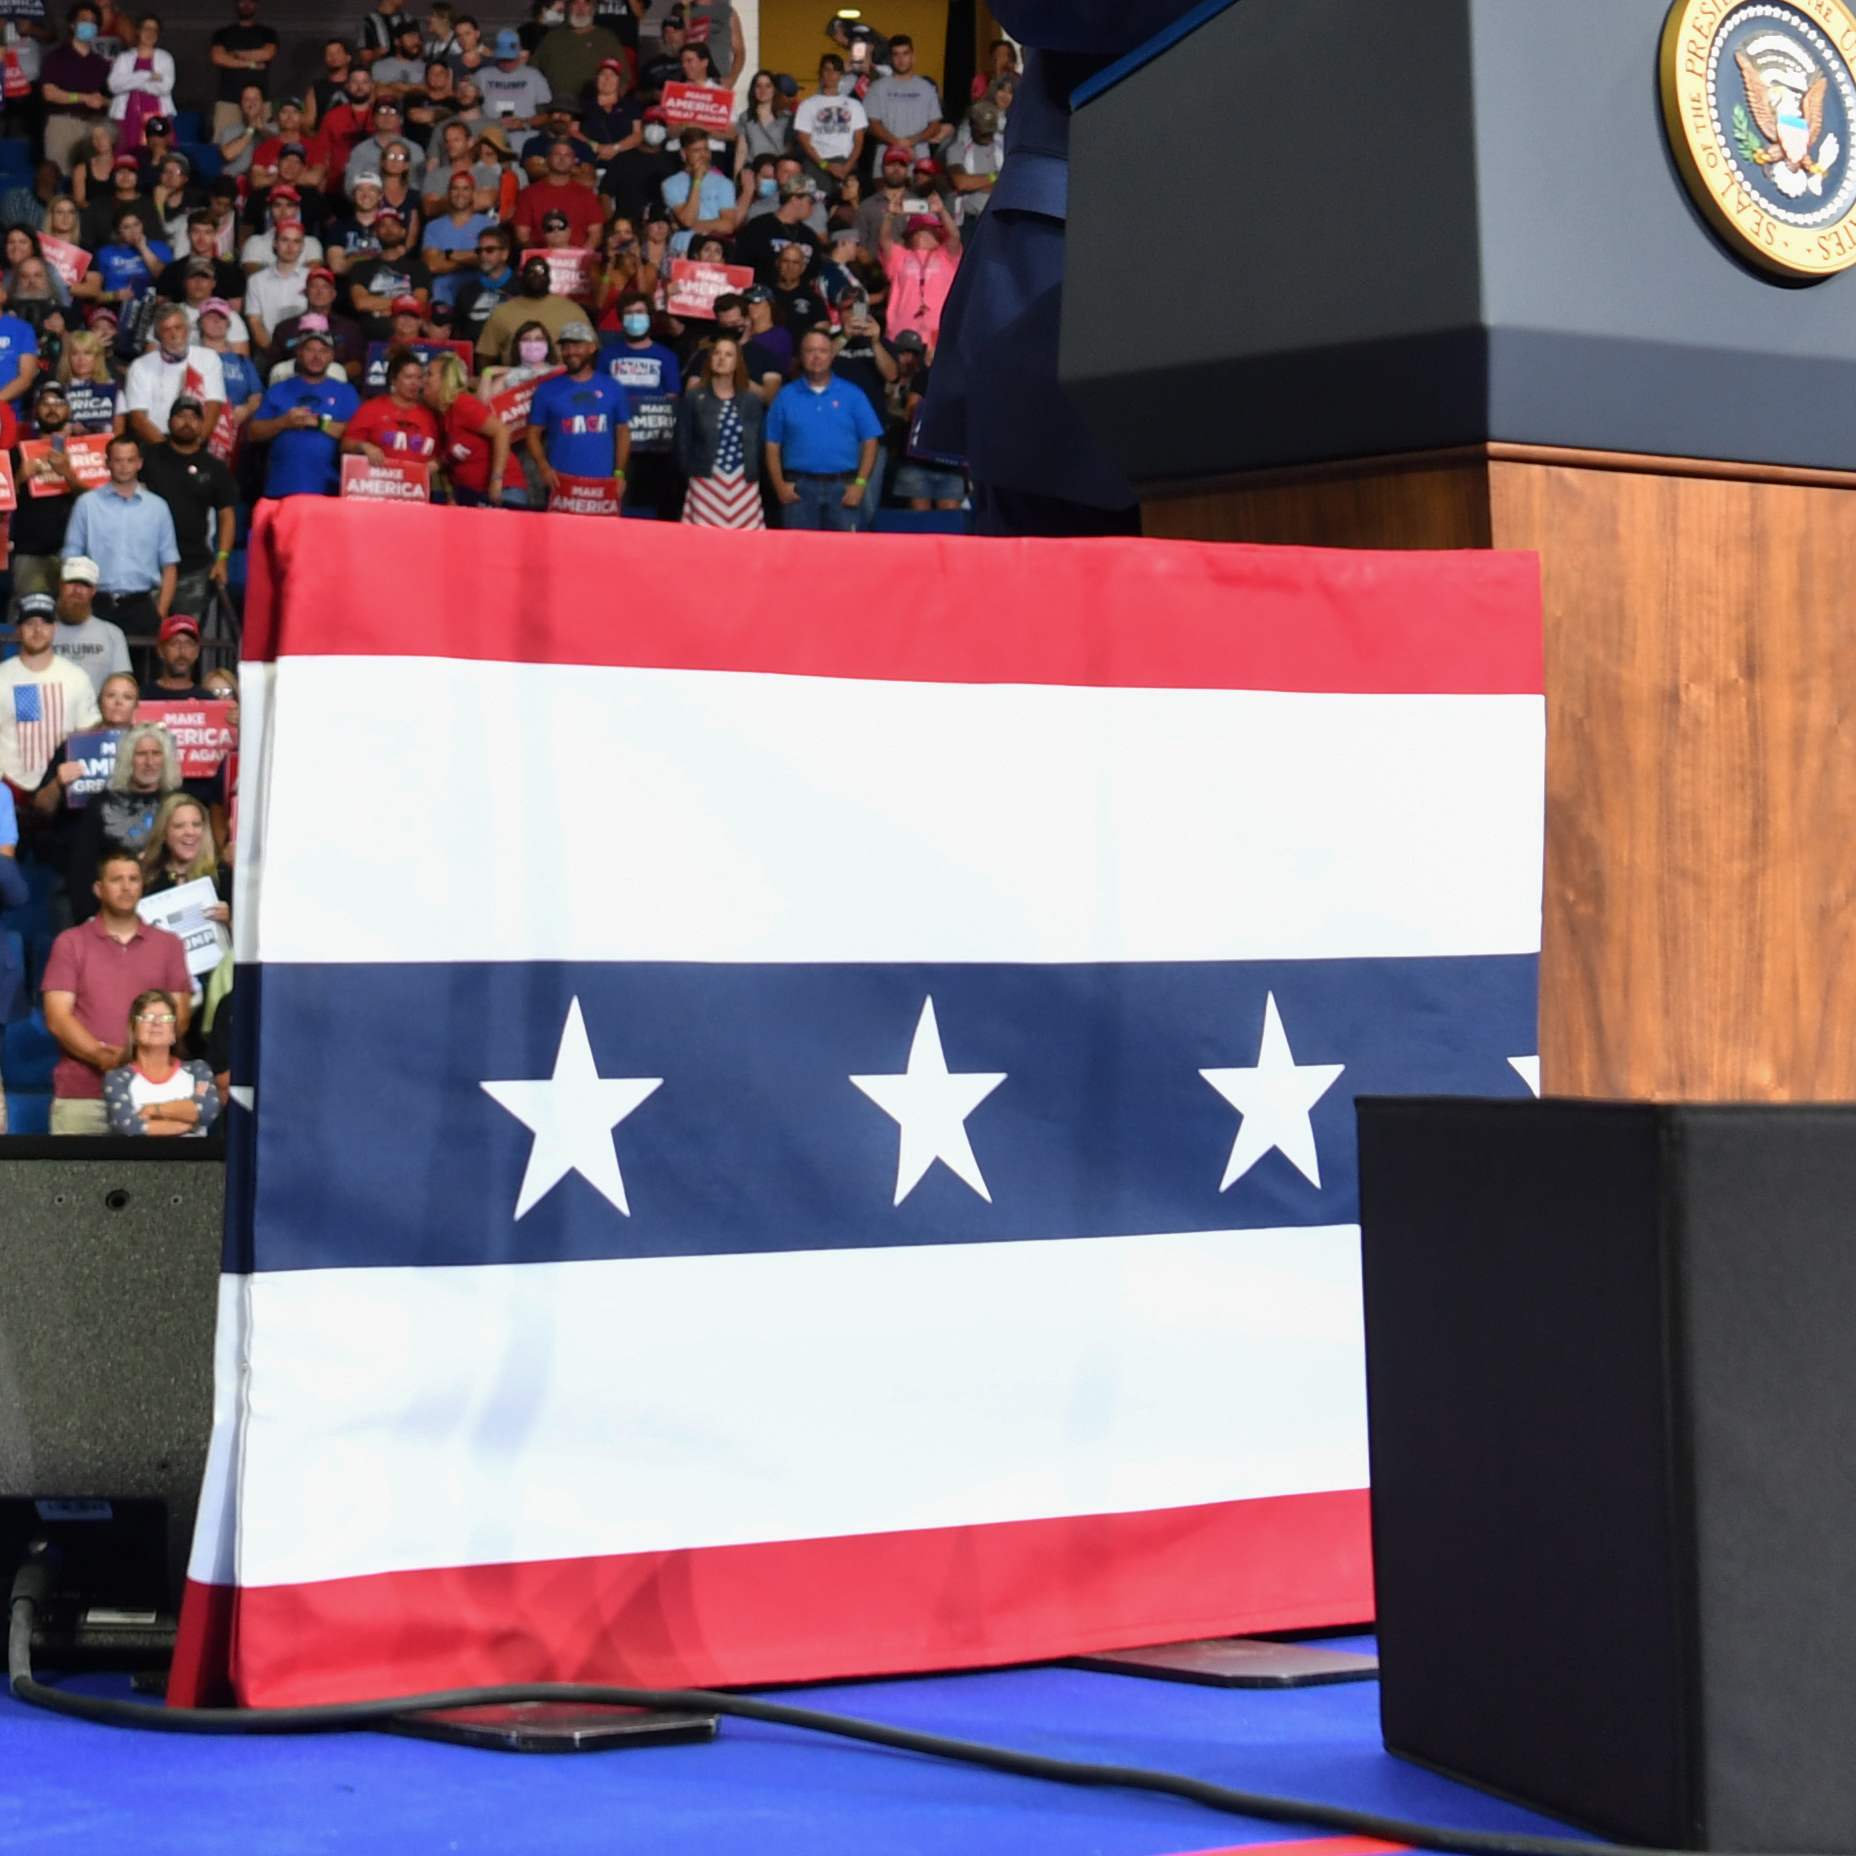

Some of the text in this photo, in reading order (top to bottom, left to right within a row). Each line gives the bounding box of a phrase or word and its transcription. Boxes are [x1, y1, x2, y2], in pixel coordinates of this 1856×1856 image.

[665, 96, 730, 115] AMERICA
[1721, 173, 1776, 245] SEAL
[346, 477, 426, 496] AMERICA
[551, 496, 618, 514] AMERICA
[164, 711, 206, 724] MAKE
[174, 727, 233, 747] ERICA
